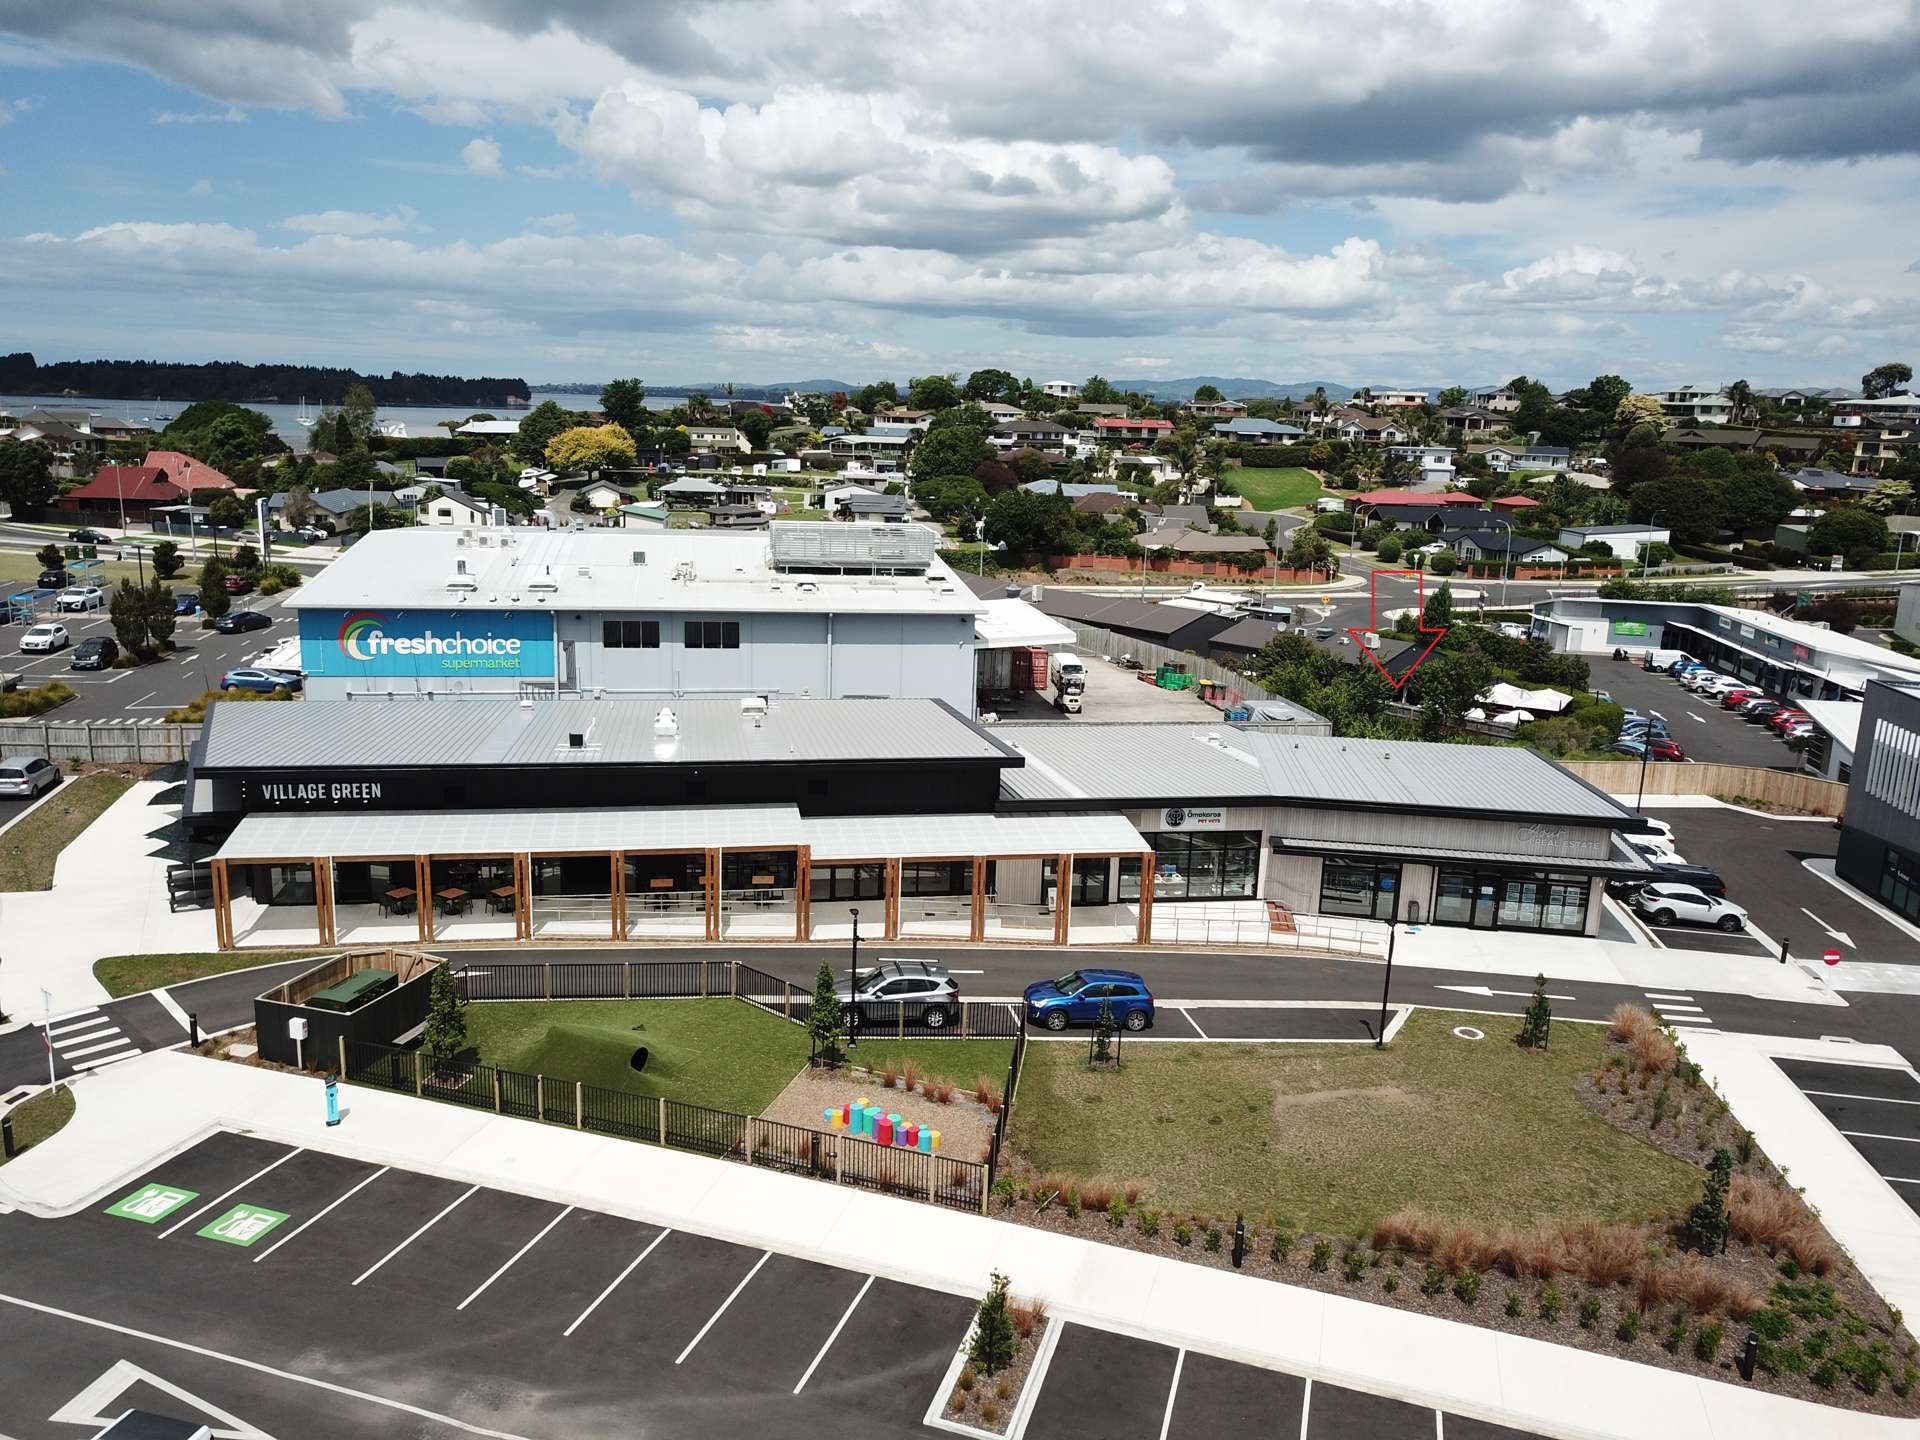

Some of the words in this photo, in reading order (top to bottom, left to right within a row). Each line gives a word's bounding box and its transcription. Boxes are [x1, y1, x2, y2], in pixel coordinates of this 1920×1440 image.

[367, 630, 521, 655] freshchoice
[441, 657, 521, 670] supermarket
[262, 783, 327, 800] VILLAGE
[331, 782, 382, 799] GREEN
[1535, 838, 1560, 847] REAL
[1563, 840, 1601, 850] ESTATE
